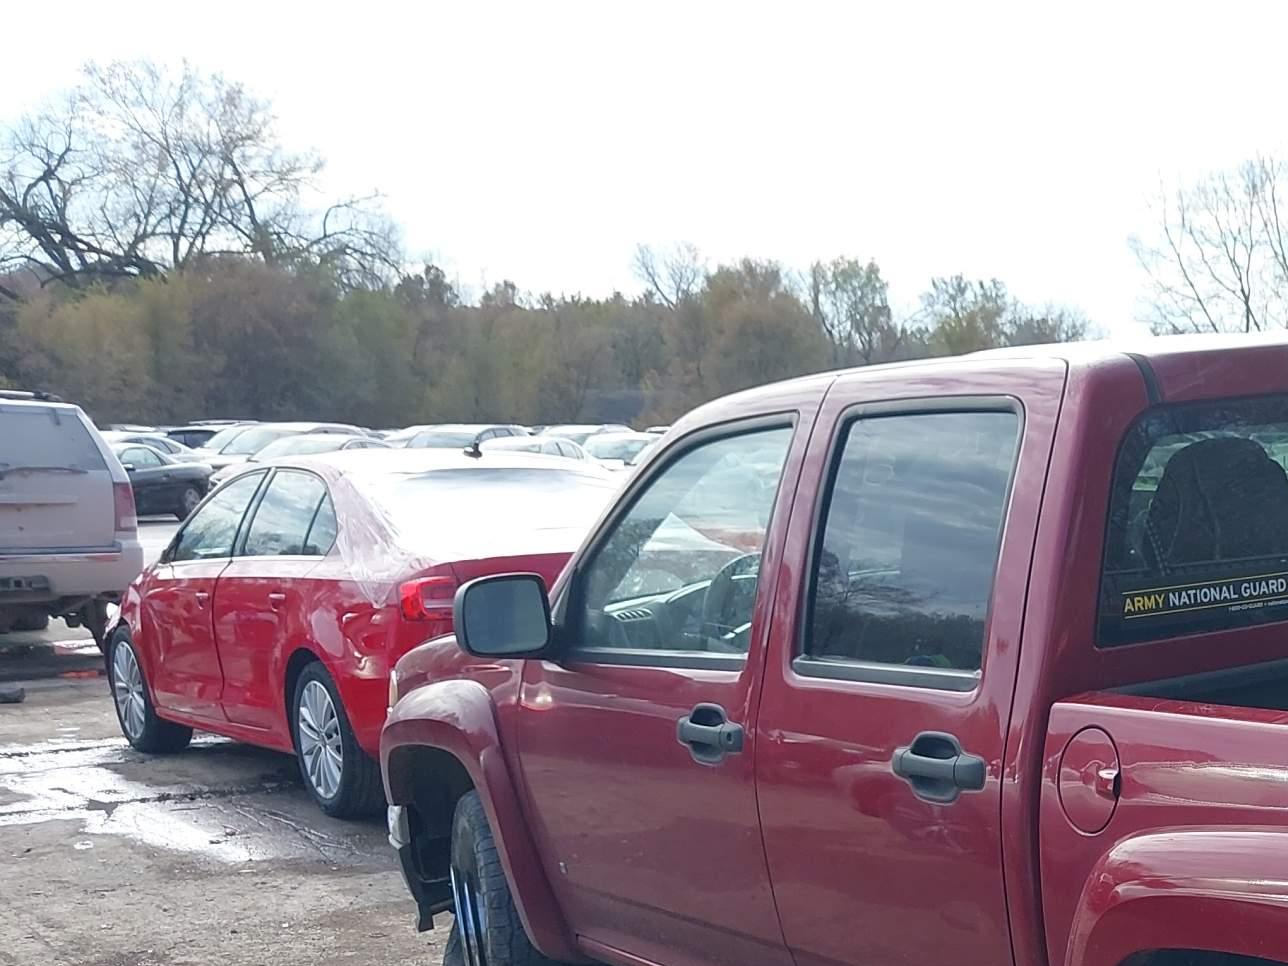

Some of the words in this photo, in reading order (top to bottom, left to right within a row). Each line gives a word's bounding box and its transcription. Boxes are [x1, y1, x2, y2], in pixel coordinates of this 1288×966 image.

[1123, 592, 1166, 614] ARMY
[1168, 585, 1239, 608] NATIONAL
[1240, 578, 1288, 598] GUARD
